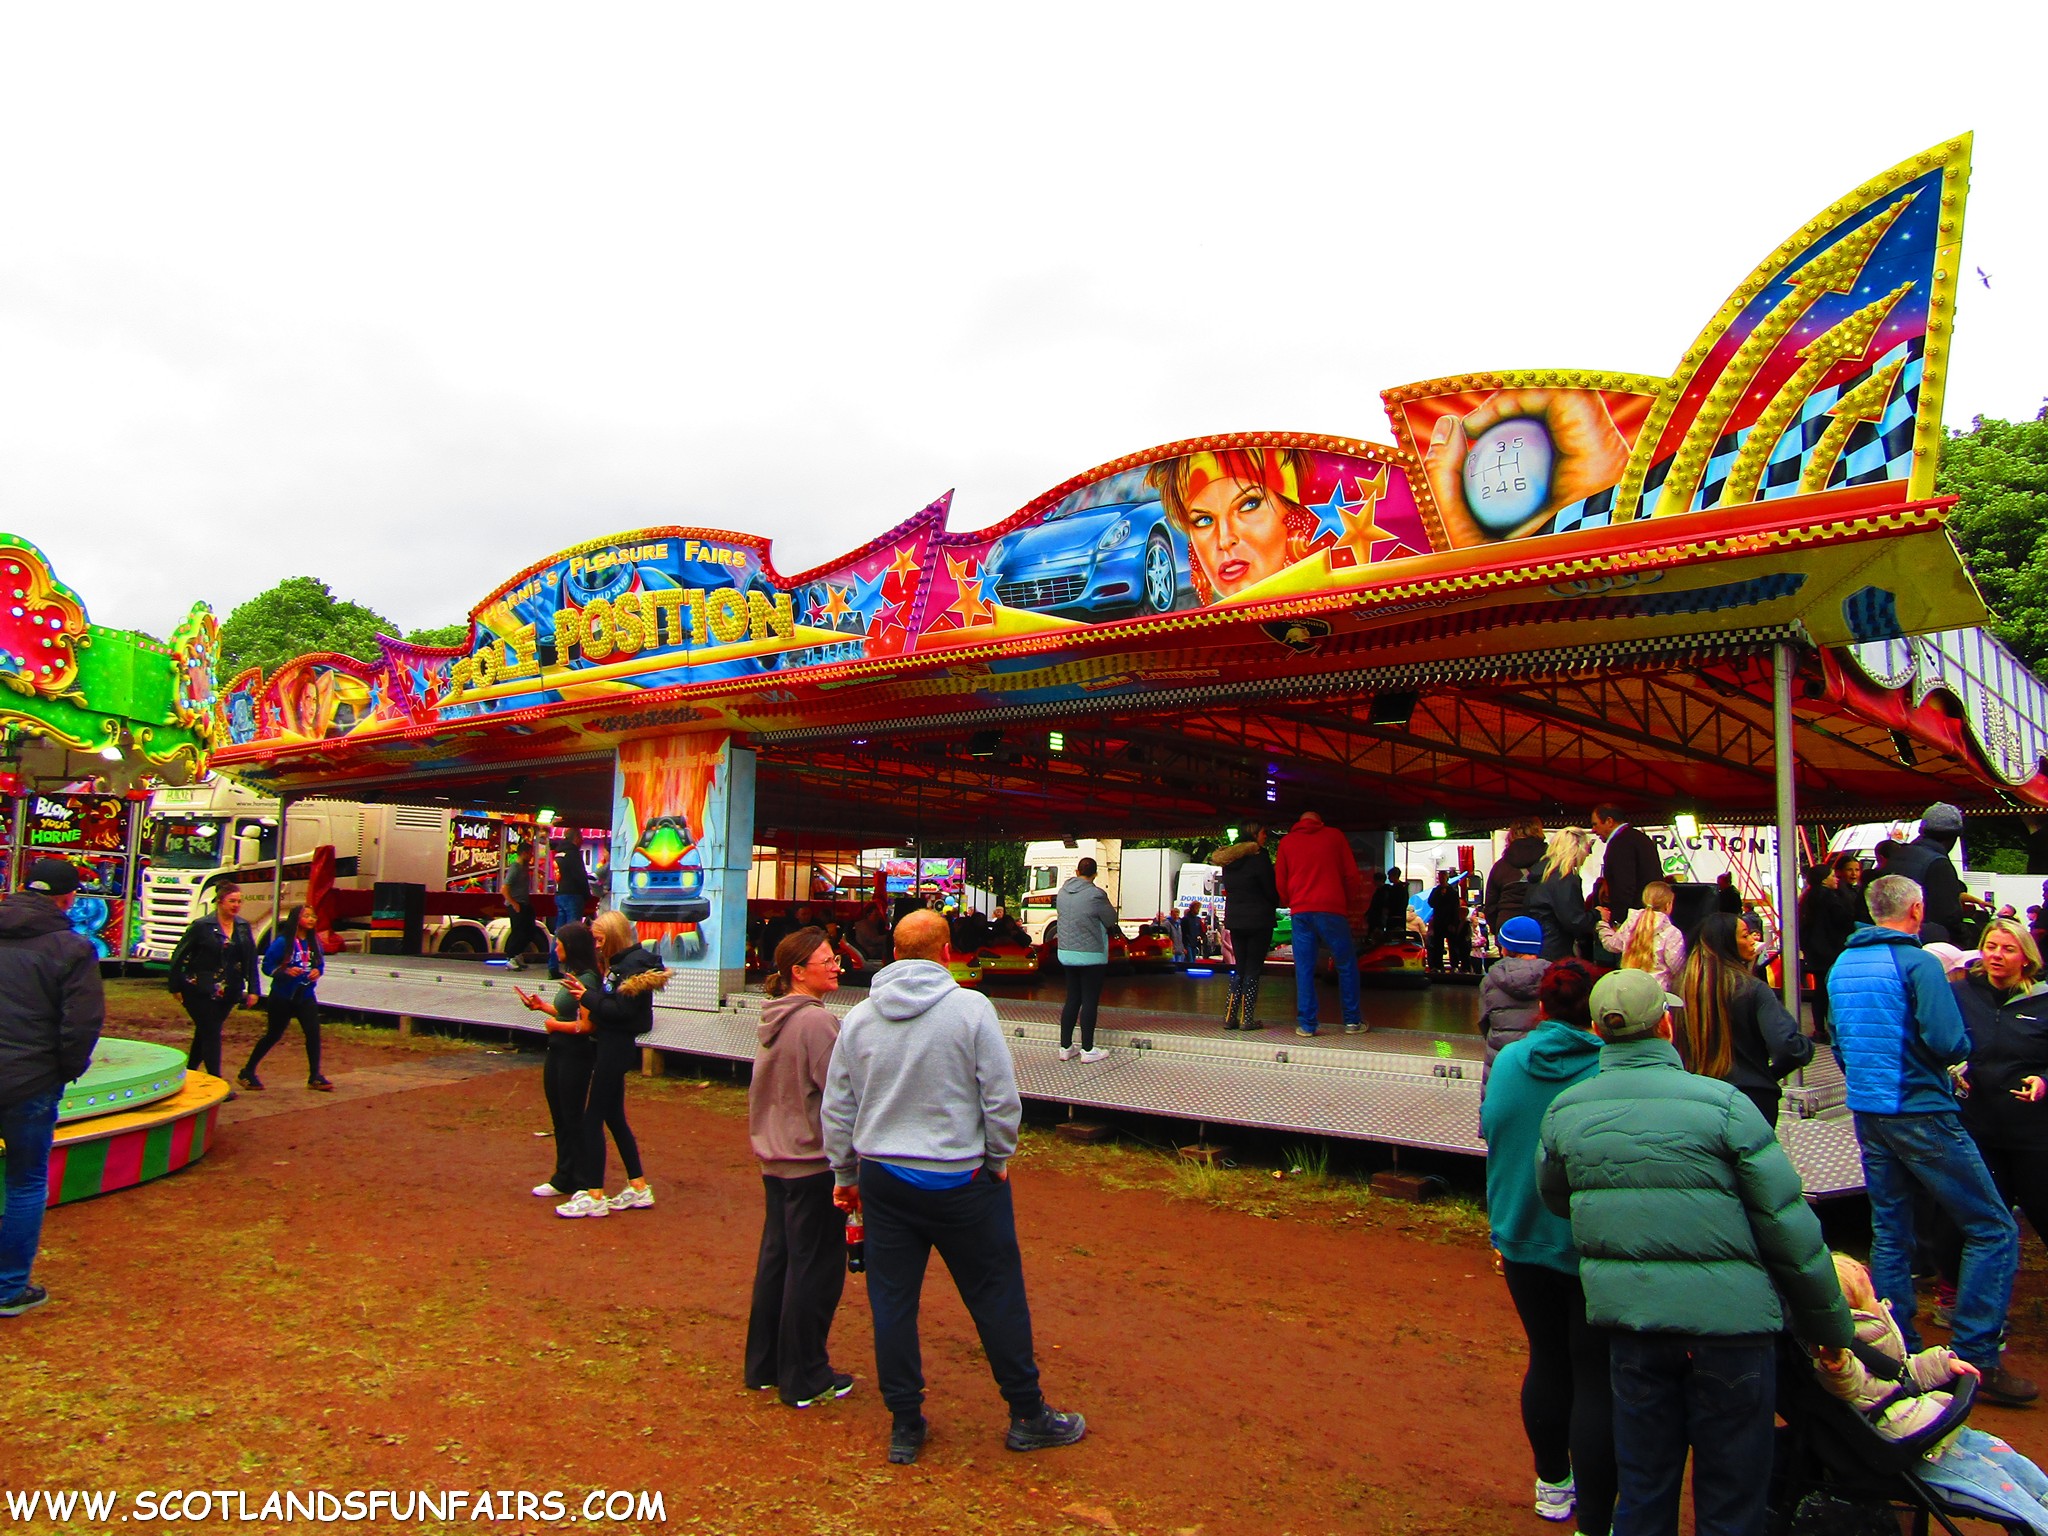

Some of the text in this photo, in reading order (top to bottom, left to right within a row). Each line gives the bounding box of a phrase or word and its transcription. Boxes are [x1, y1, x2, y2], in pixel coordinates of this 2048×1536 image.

[568, 544, 669, 577] PLEASURE
[684, 540, 747, 568] FAIRS
[450, 587, 797, 697] POLE POSITION
[36, 797, 74, 820] BLOW
[40, 818, 72, 830] YOUR
[31, 829, 82, 845] HORNE
[464, 839, 490, 848] BEAT
[157, 876, 180, 884] SCANIA
